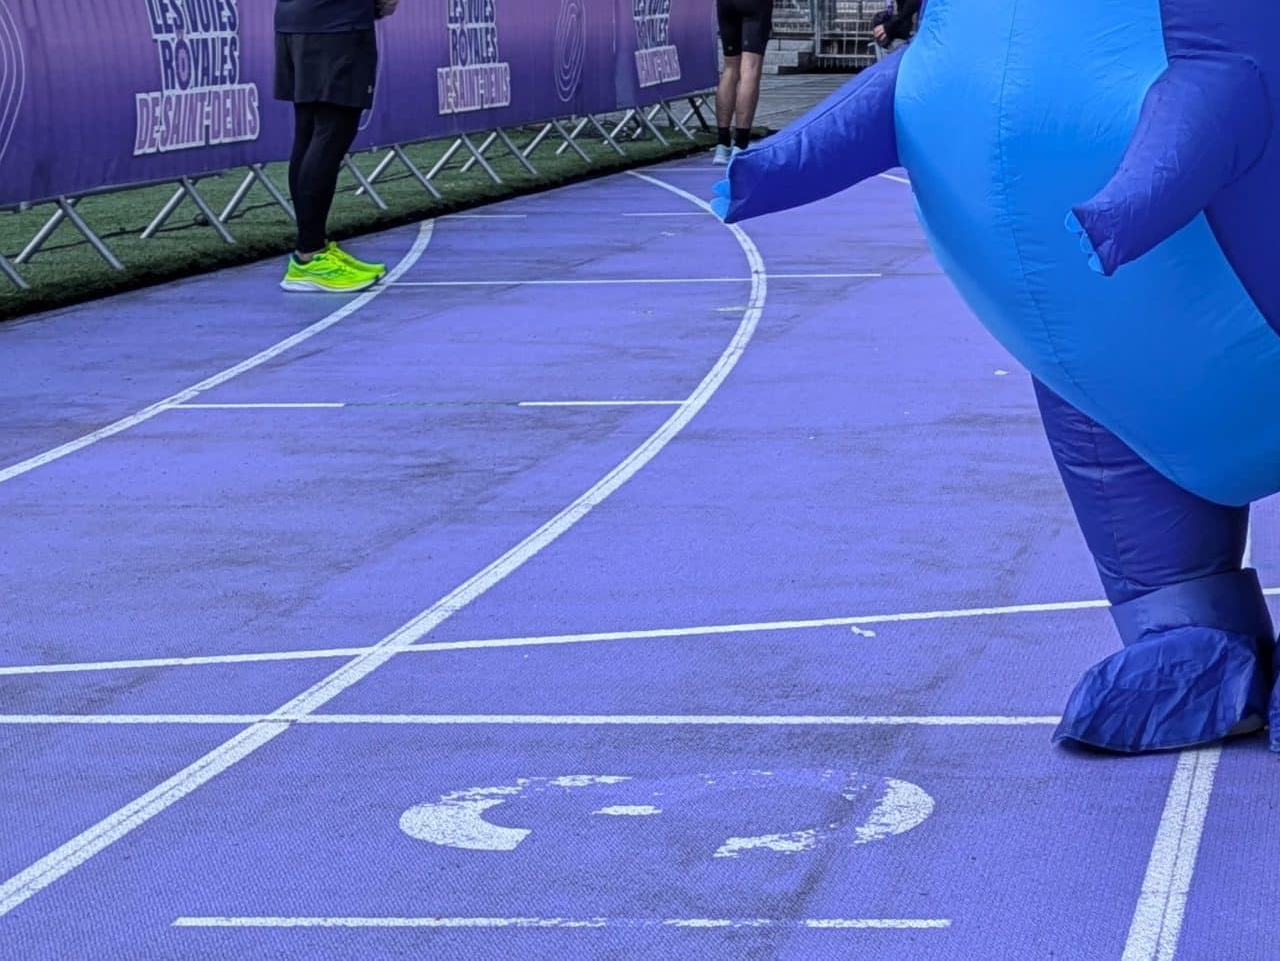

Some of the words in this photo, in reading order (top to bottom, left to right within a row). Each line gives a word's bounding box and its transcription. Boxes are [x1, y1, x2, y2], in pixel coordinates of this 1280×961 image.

[158, 33, 239, 91] ROYALES
[449, 25, 498, 66] ROYALES
[134, 92, 161, 155] DE
[159, 83, 260, 152] SAINT-DENIS
